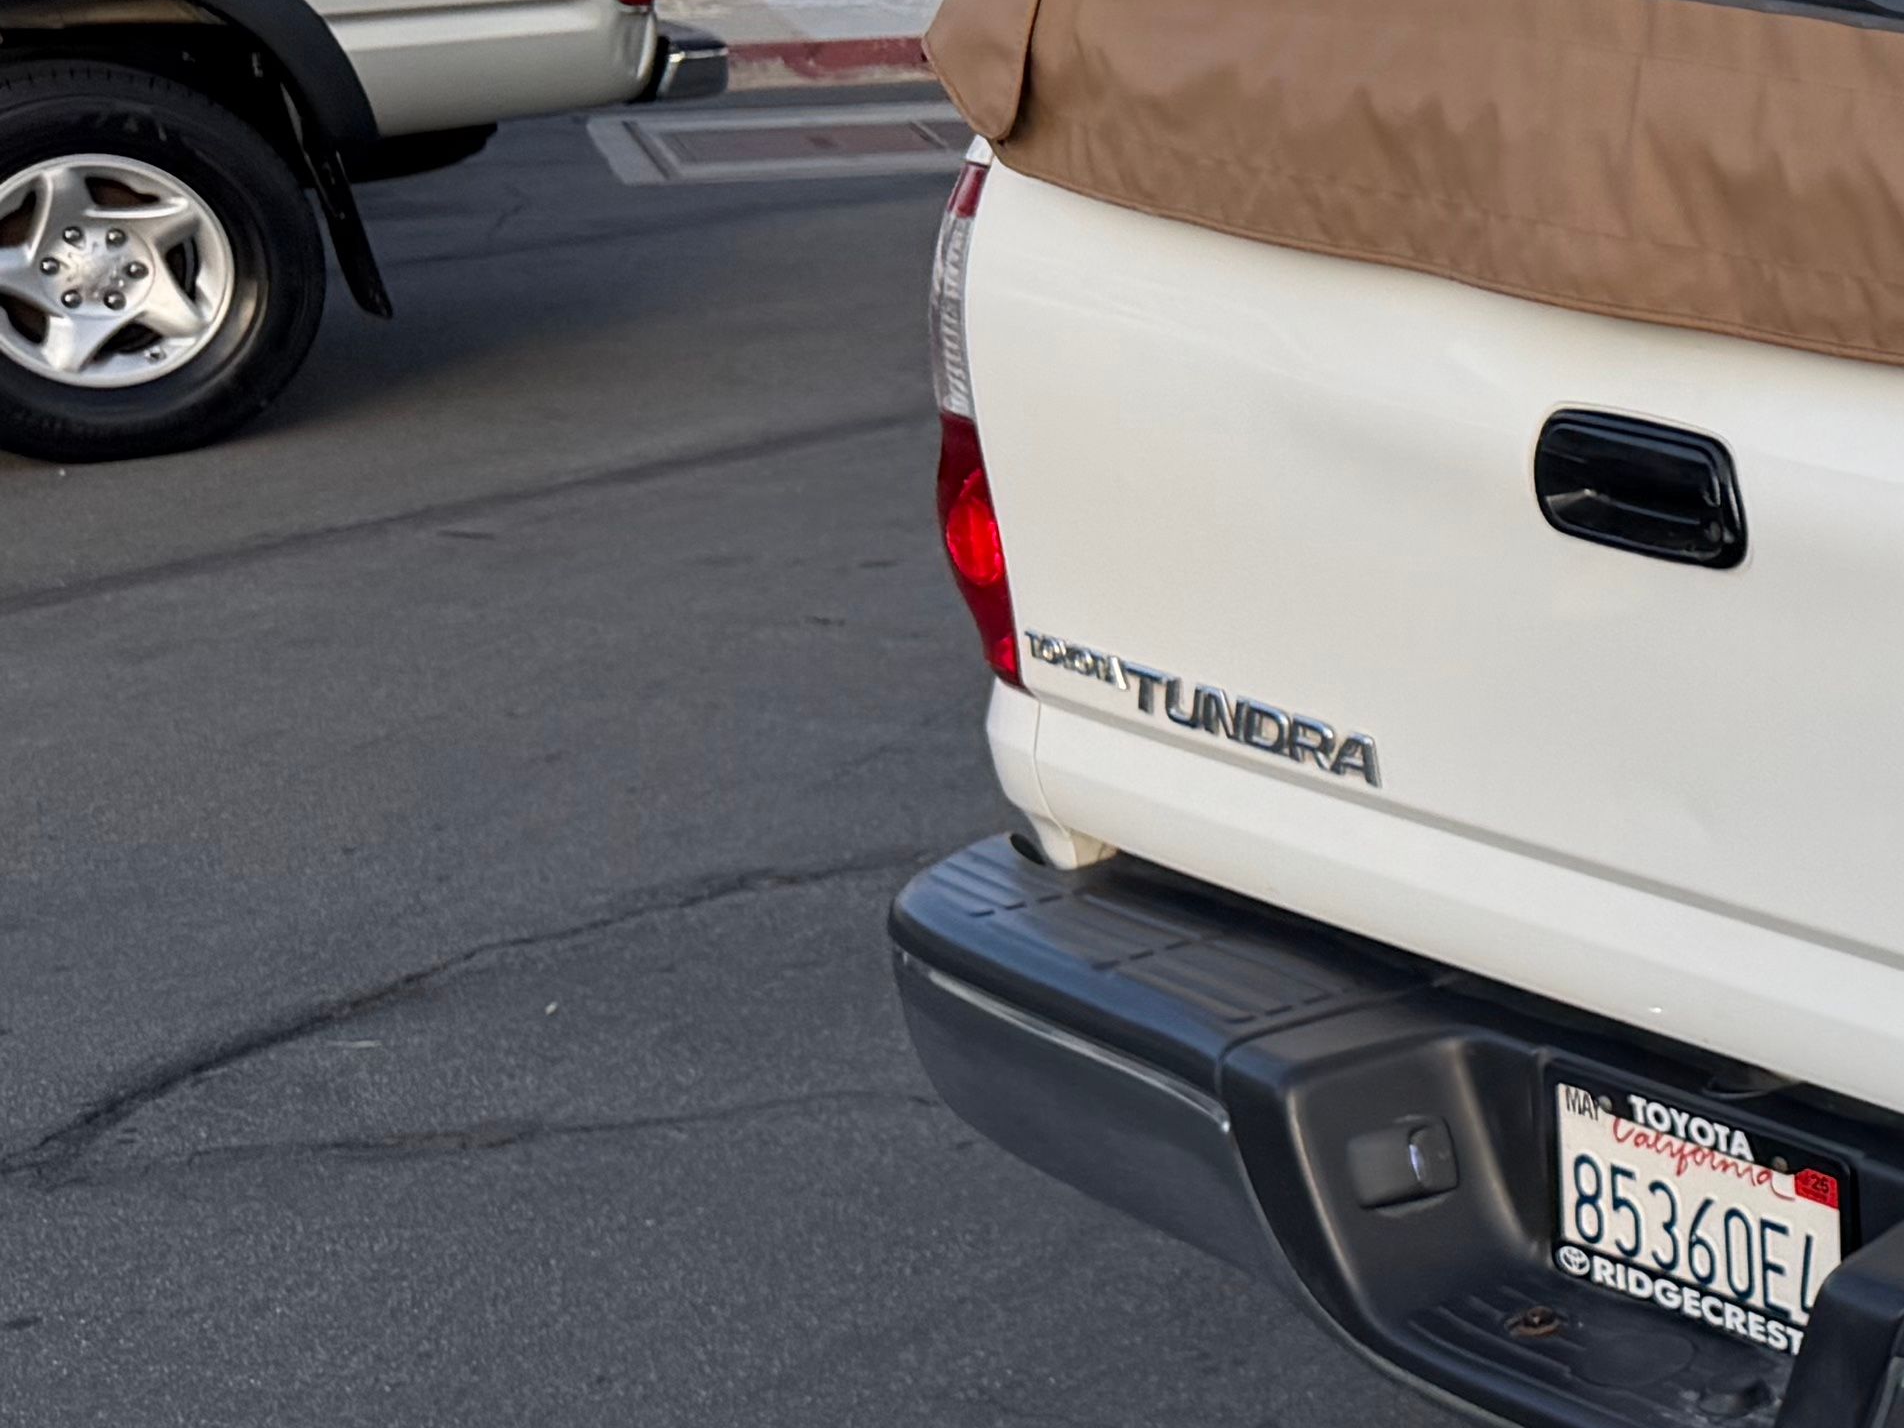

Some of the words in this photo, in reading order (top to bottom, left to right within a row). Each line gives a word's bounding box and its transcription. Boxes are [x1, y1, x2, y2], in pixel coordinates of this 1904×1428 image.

[1025, 628, 1131, 691] TOYOTA
[1126, 661, 1383, 789] TUNDRA
[1612, 1117, 1796, 1201] California
[1627, 1093, 1755, 1162] TOYOTA
[1588, 1255, 1805, 1356] RIDGECREST
